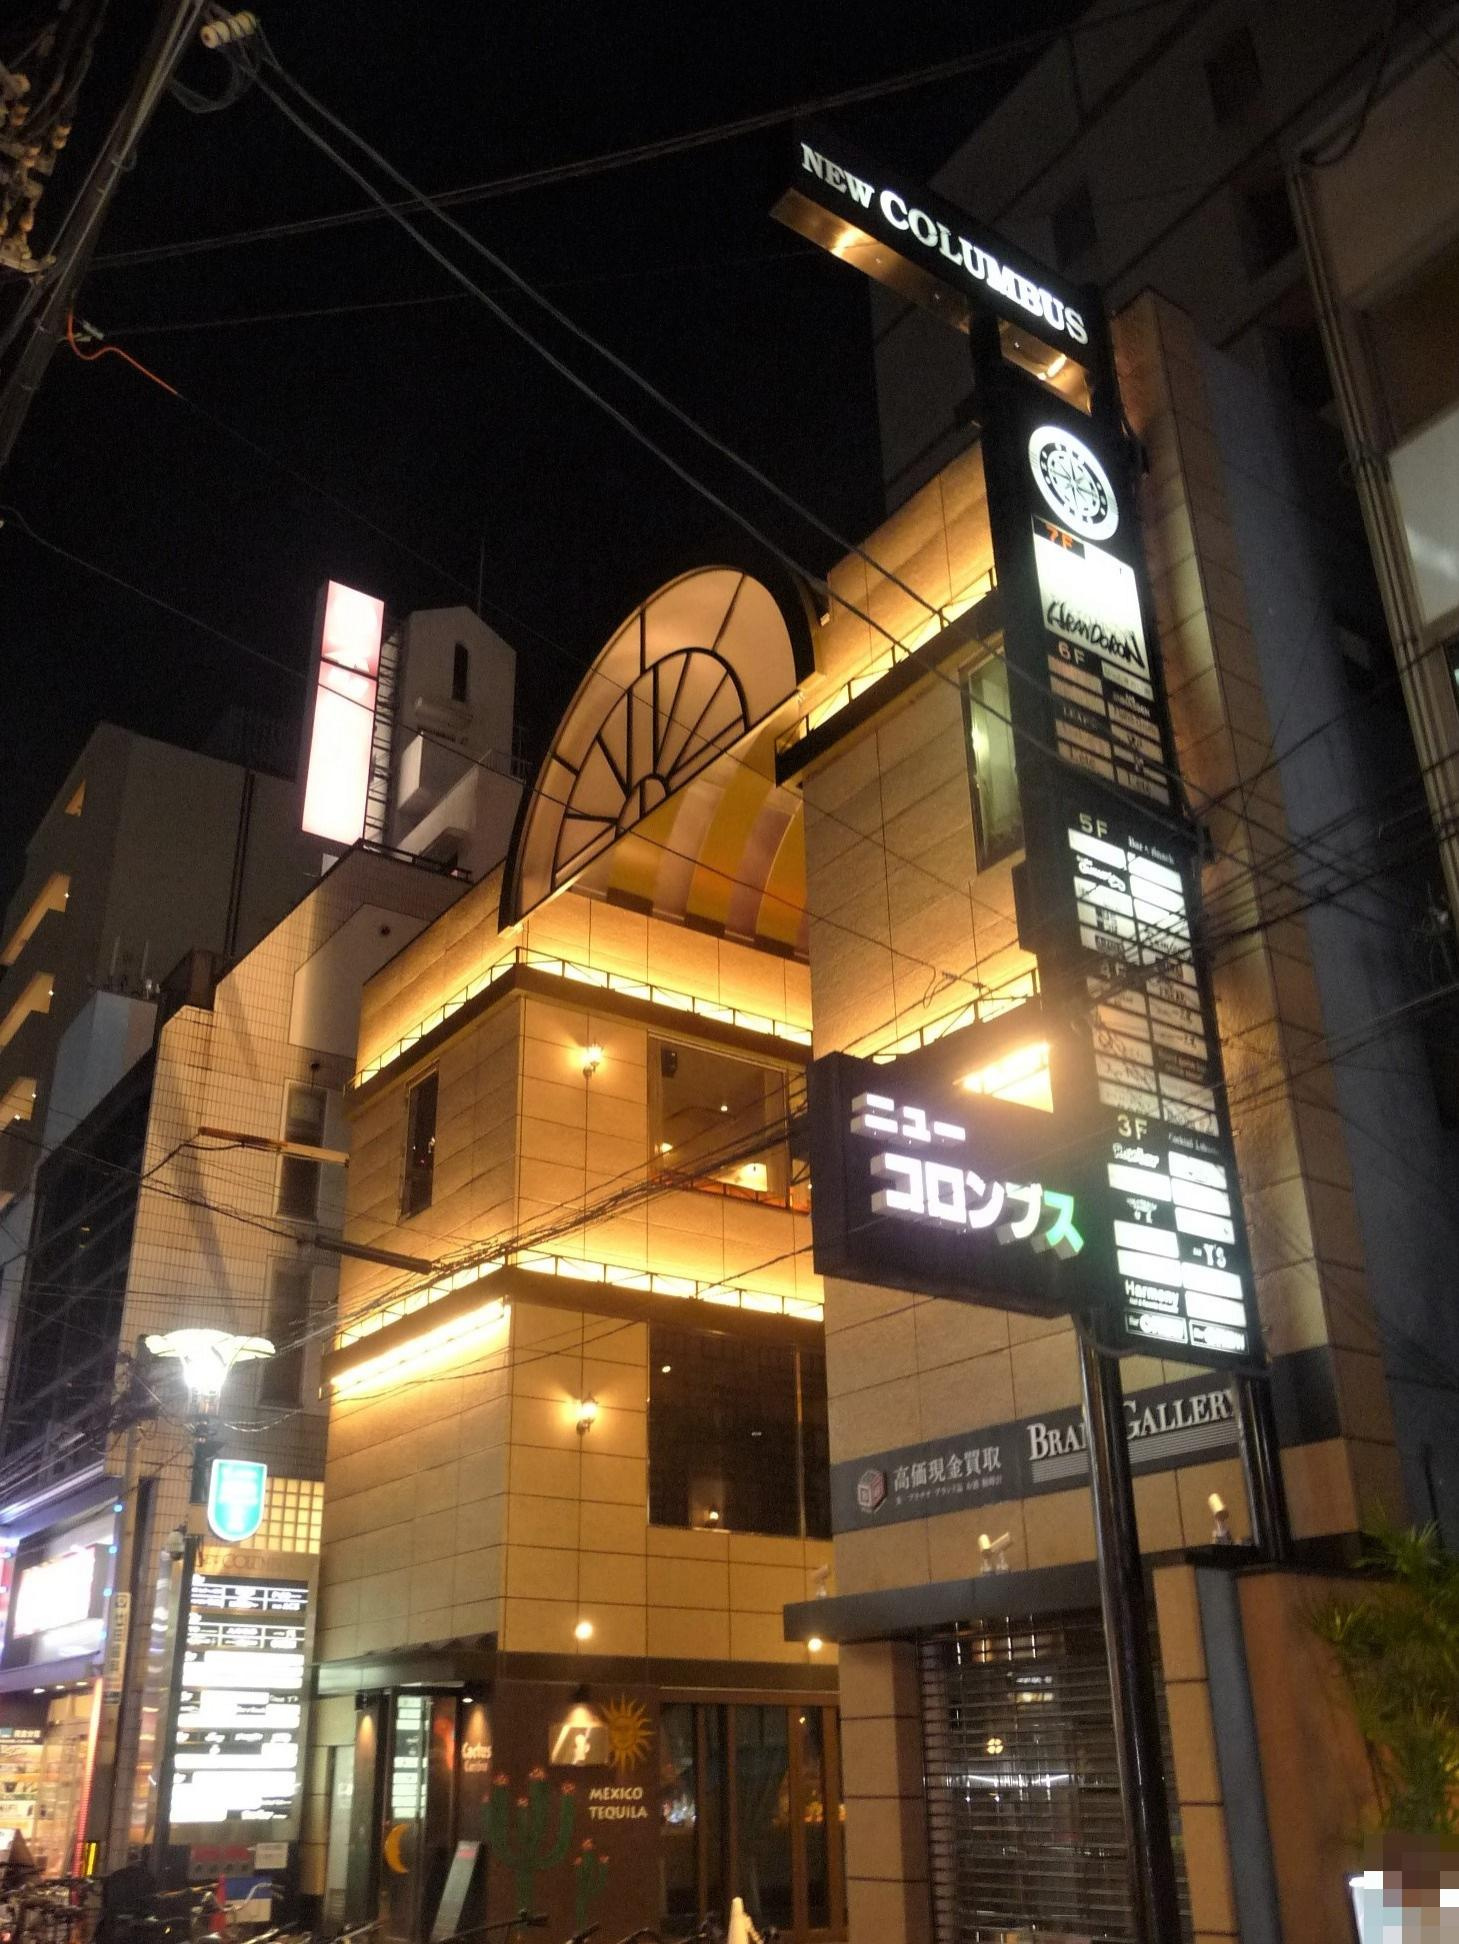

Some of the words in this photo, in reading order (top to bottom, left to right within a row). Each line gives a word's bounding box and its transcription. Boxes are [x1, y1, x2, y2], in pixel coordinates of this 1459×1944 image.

[800, 141, 876, 209] NEW
[879, 189, 1089, 346] COLUMBUS
[851, 1092, 966, 1143] ニュー
[1117, 1113, 1148, 1140] 3F
[894, 1446, 1002, 1492] 高価現金買取
[589, 1786, 644, 1801] MEXICO
[589, 1806, 648, 1820] TEQUILA
